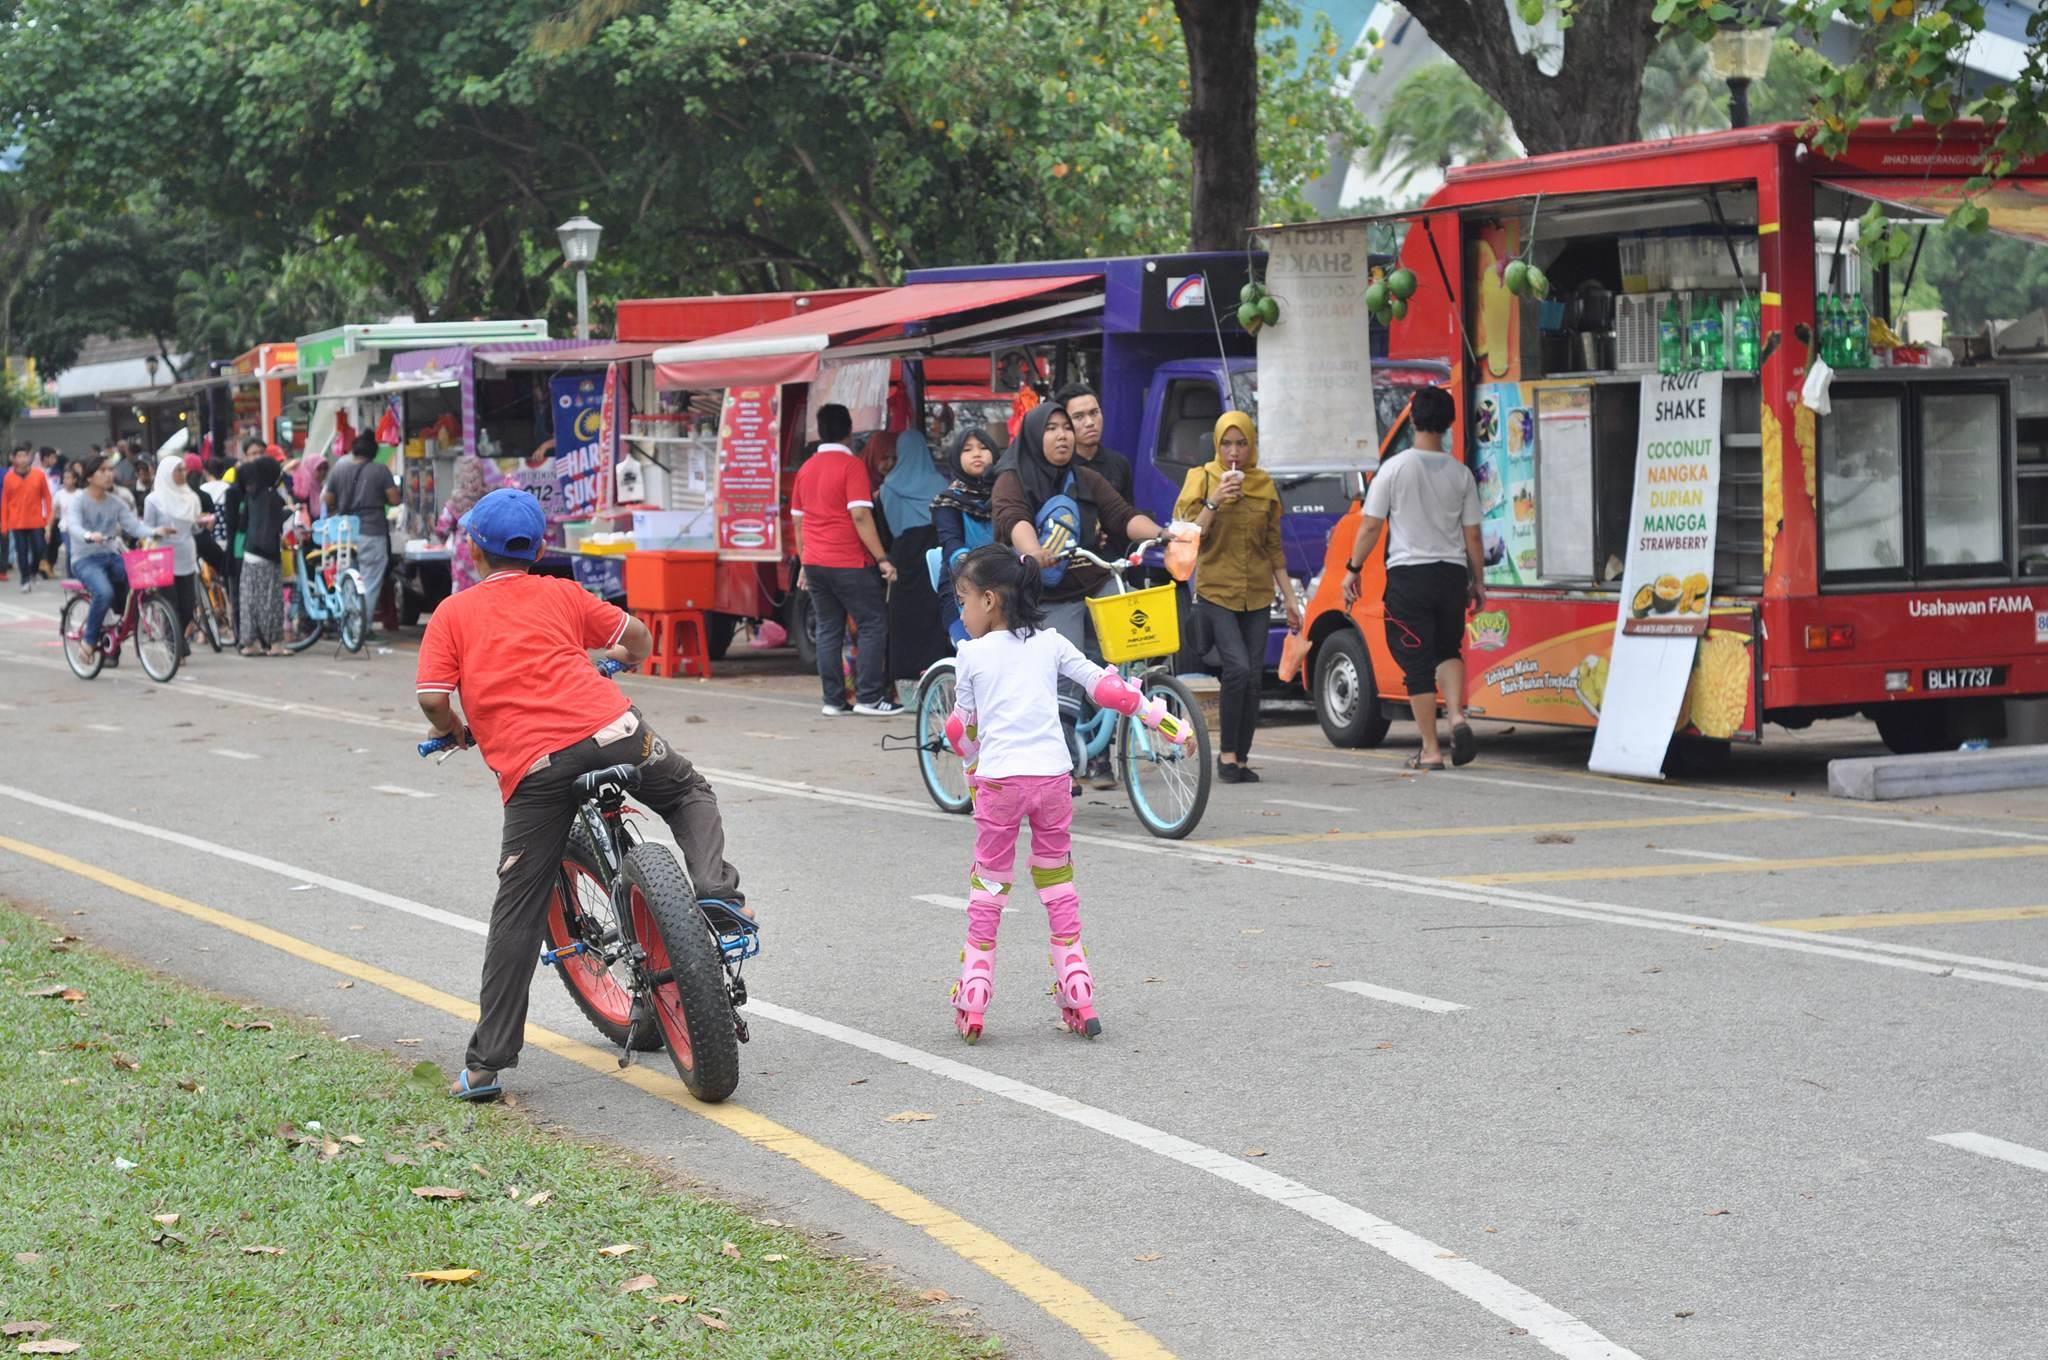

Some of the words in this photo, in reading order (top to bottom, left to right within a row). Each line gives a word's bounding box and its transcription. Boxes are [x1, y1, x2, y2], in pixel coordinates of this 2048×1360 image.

[1660, 371, 1702, 392] FRUIT
[1656, 398, 1706, 421] SHAKE
[1647, 439, 1712, 459] COCONUT
[1647, 464, 1709, 484] NANGKA
[1650, 489, 1703, 508] DURIAN
[1643, 514, 1707, 533] MANGGA
[1640, 535, 1708, 551] STRAWBERRY
[1909, 598, 1986, 617] Usahawan
[1989, 595, 2034, 614] FAMA
[1928, 669, 1957, 689] BLH
[1959, 667, 1993, 687] 7737
